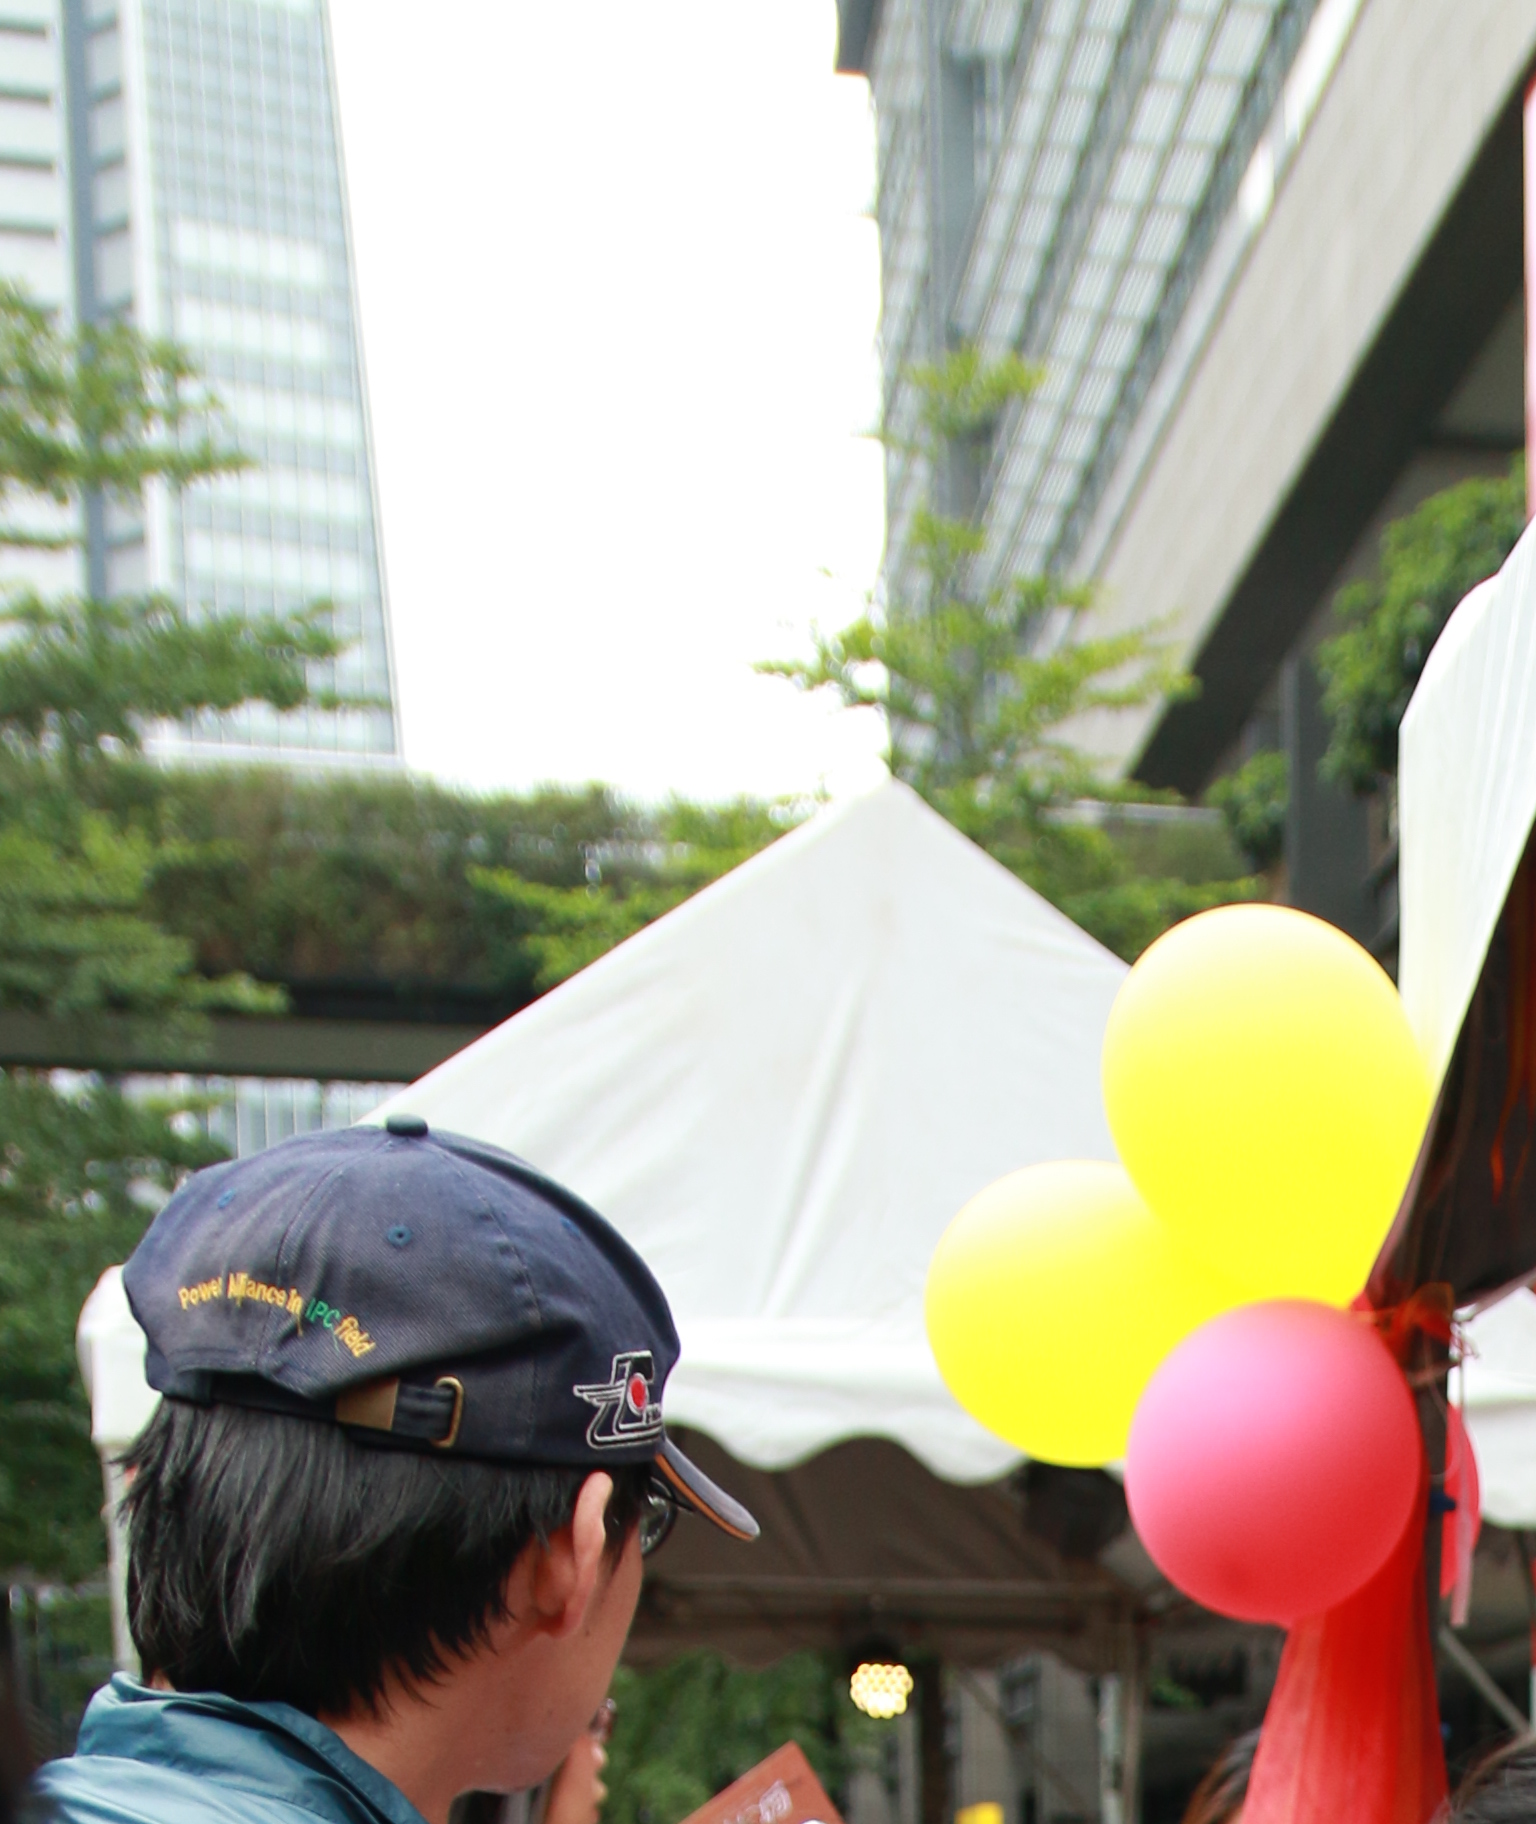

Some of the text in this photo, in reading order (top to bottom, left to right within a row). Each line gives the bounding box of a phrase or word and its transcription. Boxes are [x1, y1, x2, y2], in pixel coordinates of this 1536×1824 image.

[178, 1276, 224, 1311] Power
[227, 1271, 287, 1304] Alliance
[305, 1297, 341, 1329] IPC
[333, 1313, 376, 1359] field
